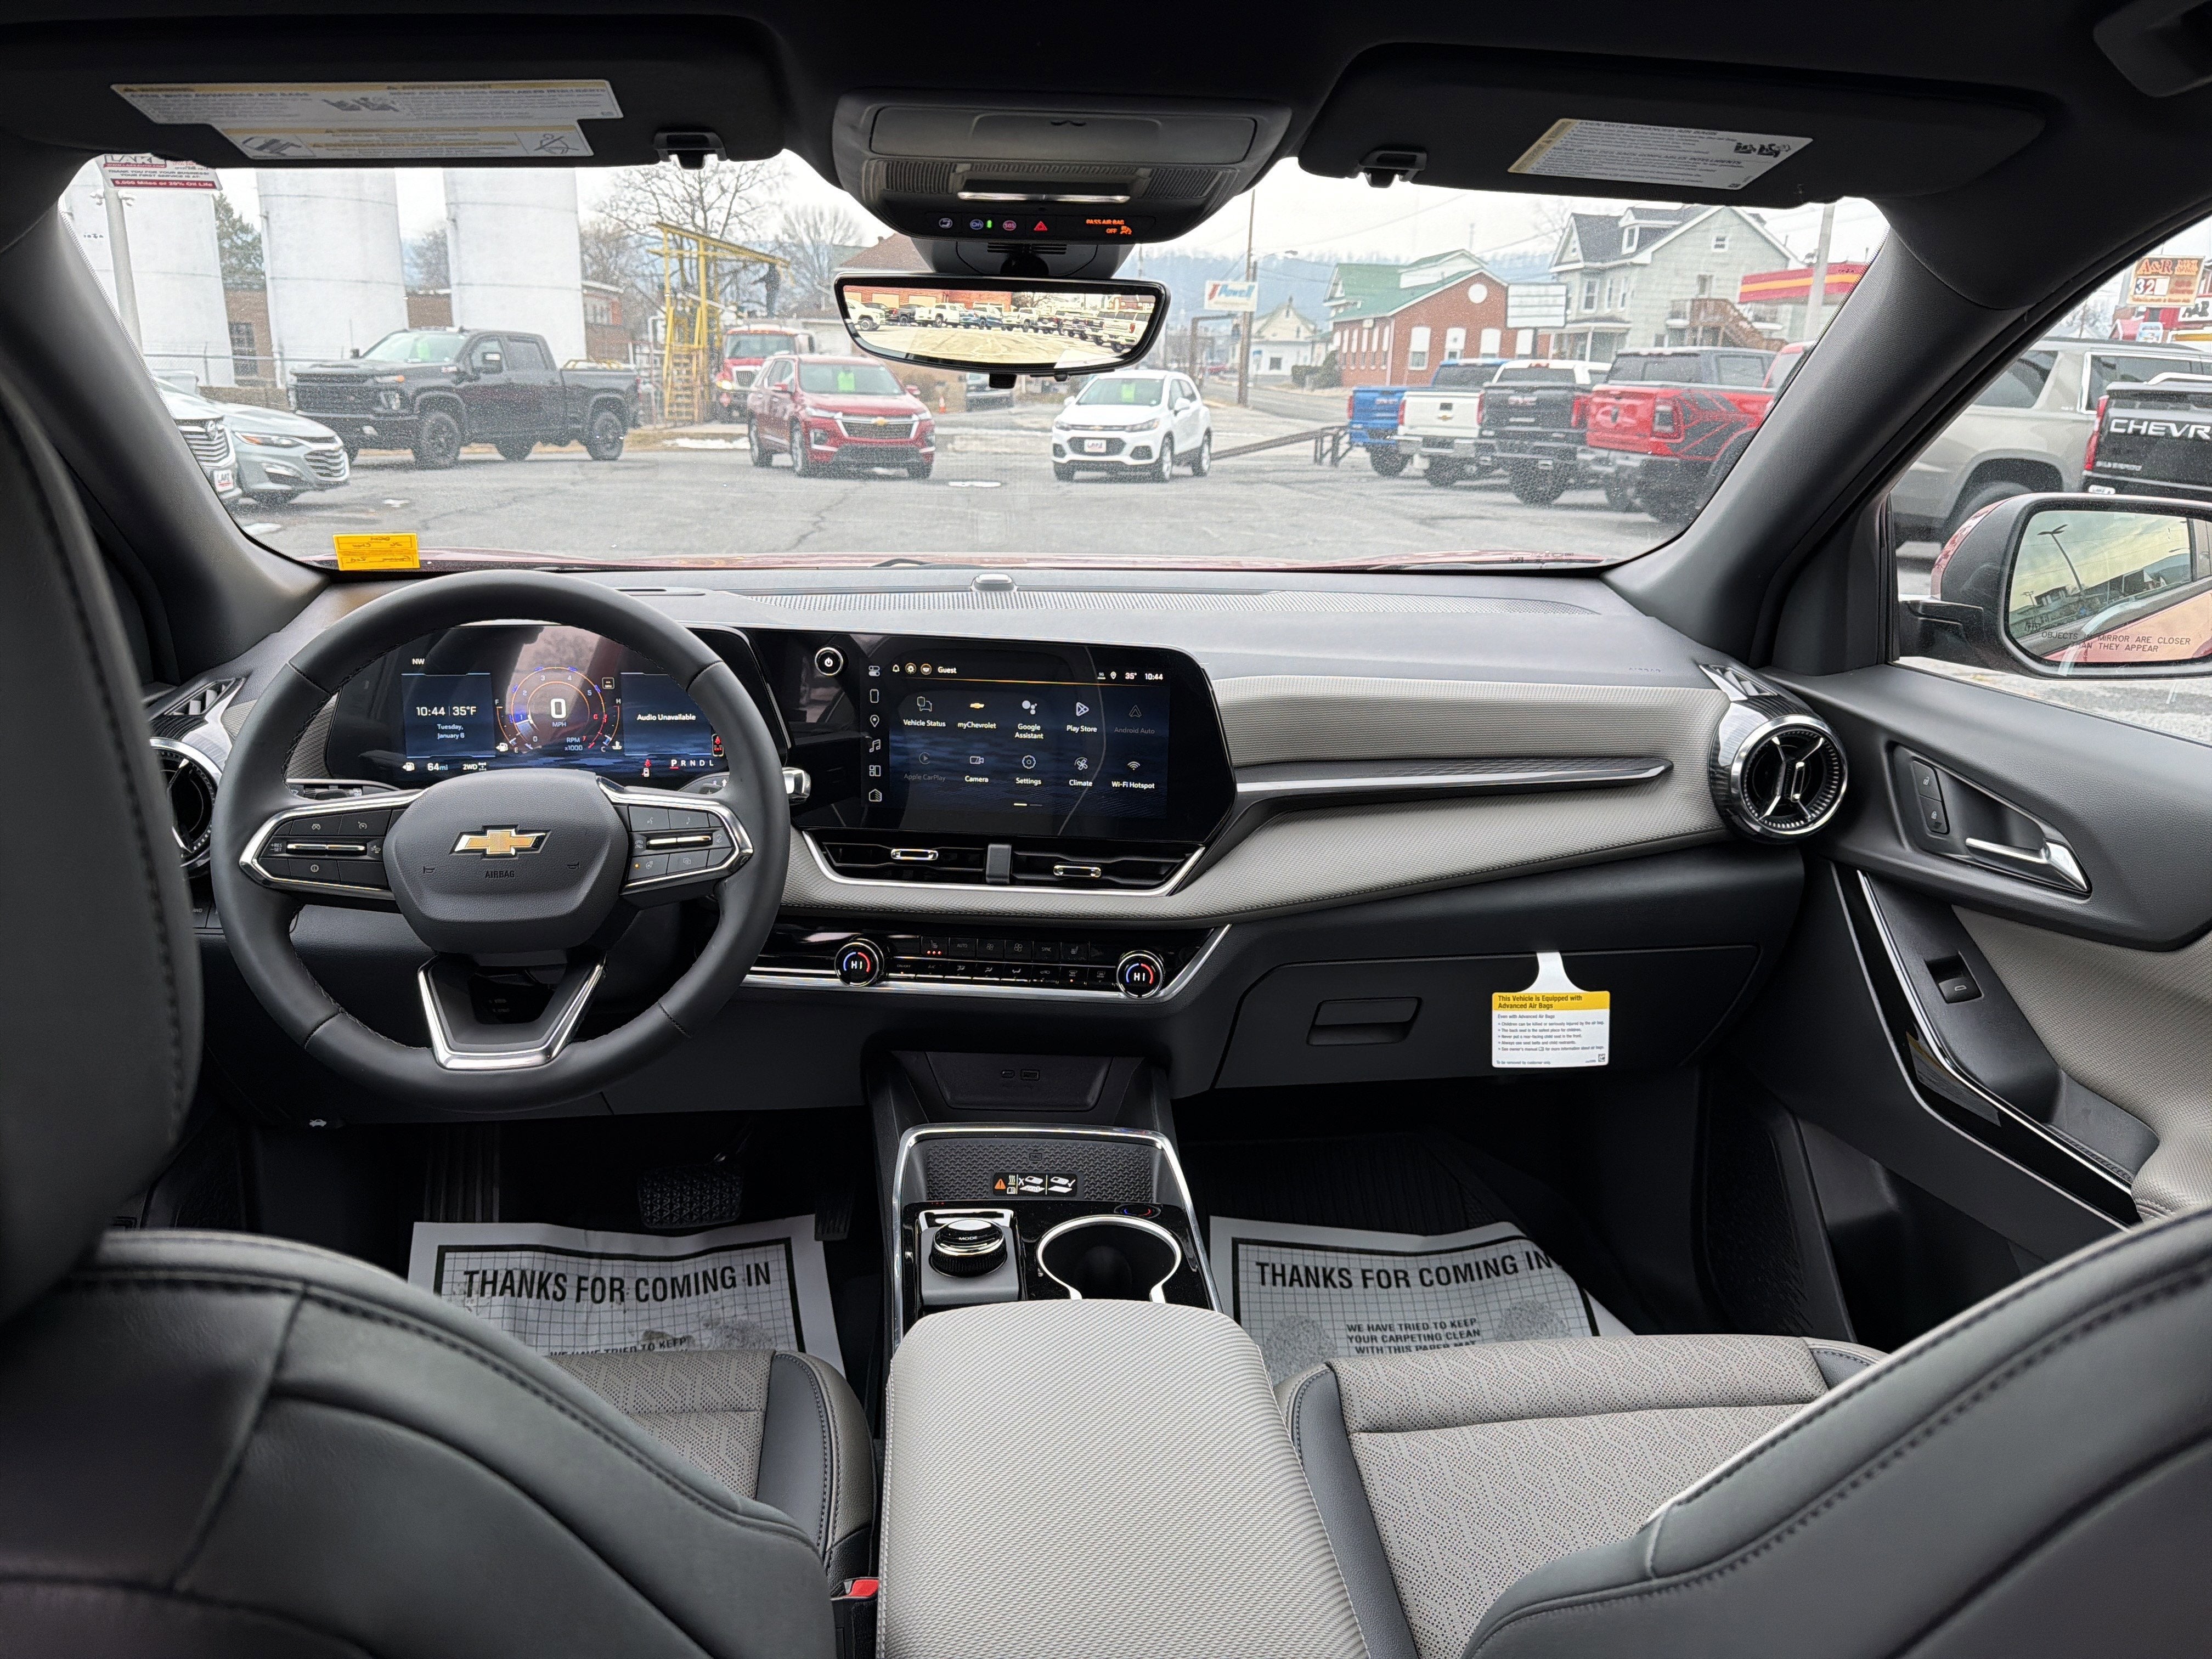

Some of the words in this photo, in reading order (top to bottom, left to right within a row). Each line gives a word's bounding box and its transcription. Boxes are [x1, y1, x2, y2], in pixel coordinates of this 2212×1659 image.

[2041, 631, 2078, 640] OBJECTS
[2098, 634, 2130, 642] MIRROR
[2135, 635, 2152, 644] ARE
[2158, 636, 2191, 645] CLOSER
[2098, 643, 2120, 651] THEY
[2124, 644, 2159, 652] APPEAR
[416, 707, 445, 716] 10:44
[452, 706, 477, 716] 35°F
[550, 698, 566, 719] 0
[957, 721, 997, 729] myChevrolet
[1018, 723, 1041, 732] Google
[1066, 725, 1079, 733] Play
[437, 732, 460, 740] January
[904, 773, 922, 781] Apple
[923, 774, 946, 782] CarPlay
[1015, 777, 1041, 786] Settings
[1129, 781, 1155, 790] Hotspot
[485, 870, 515, 878] AIRBAG
[850, 961, 863, 969] HI
[1133, 972, 1146, 981] HI
[1256, 1261, 1352, 1289] THANKS
[1362, 1268, 1410, 1289] FOR
[1421, 1252, 1518, 1286] COMING
[1527, 1249, 1552, 1271] IN
[464, 1268, 567, 1302] THANKS
[575, 1276, 625, 1304] FOR
[635, 1265, 737, 1303] COMING
[747, 1261, 771, 1287] IN
[1346, 1324, 1364, 1332] WE
[1367, 1323, 1395, 1332] HAVE
[1398, 1322, 1430, 1331] TRIED
[1432, 1321, 1447, 1330] TO
[1449, 1317, 1477, 1328] KEEP
[1347, 1334, 1378, 1344] YOUR
[1381, 1332, 1442, 1343] CARPETING
[1445, 1328, 1481, 1340] CLEAN
[641, 1342, 656, 1351] TO
[1355, 1346, 1384, 1354] WITH
[1387, 1345, 1412, 1354] THIS
